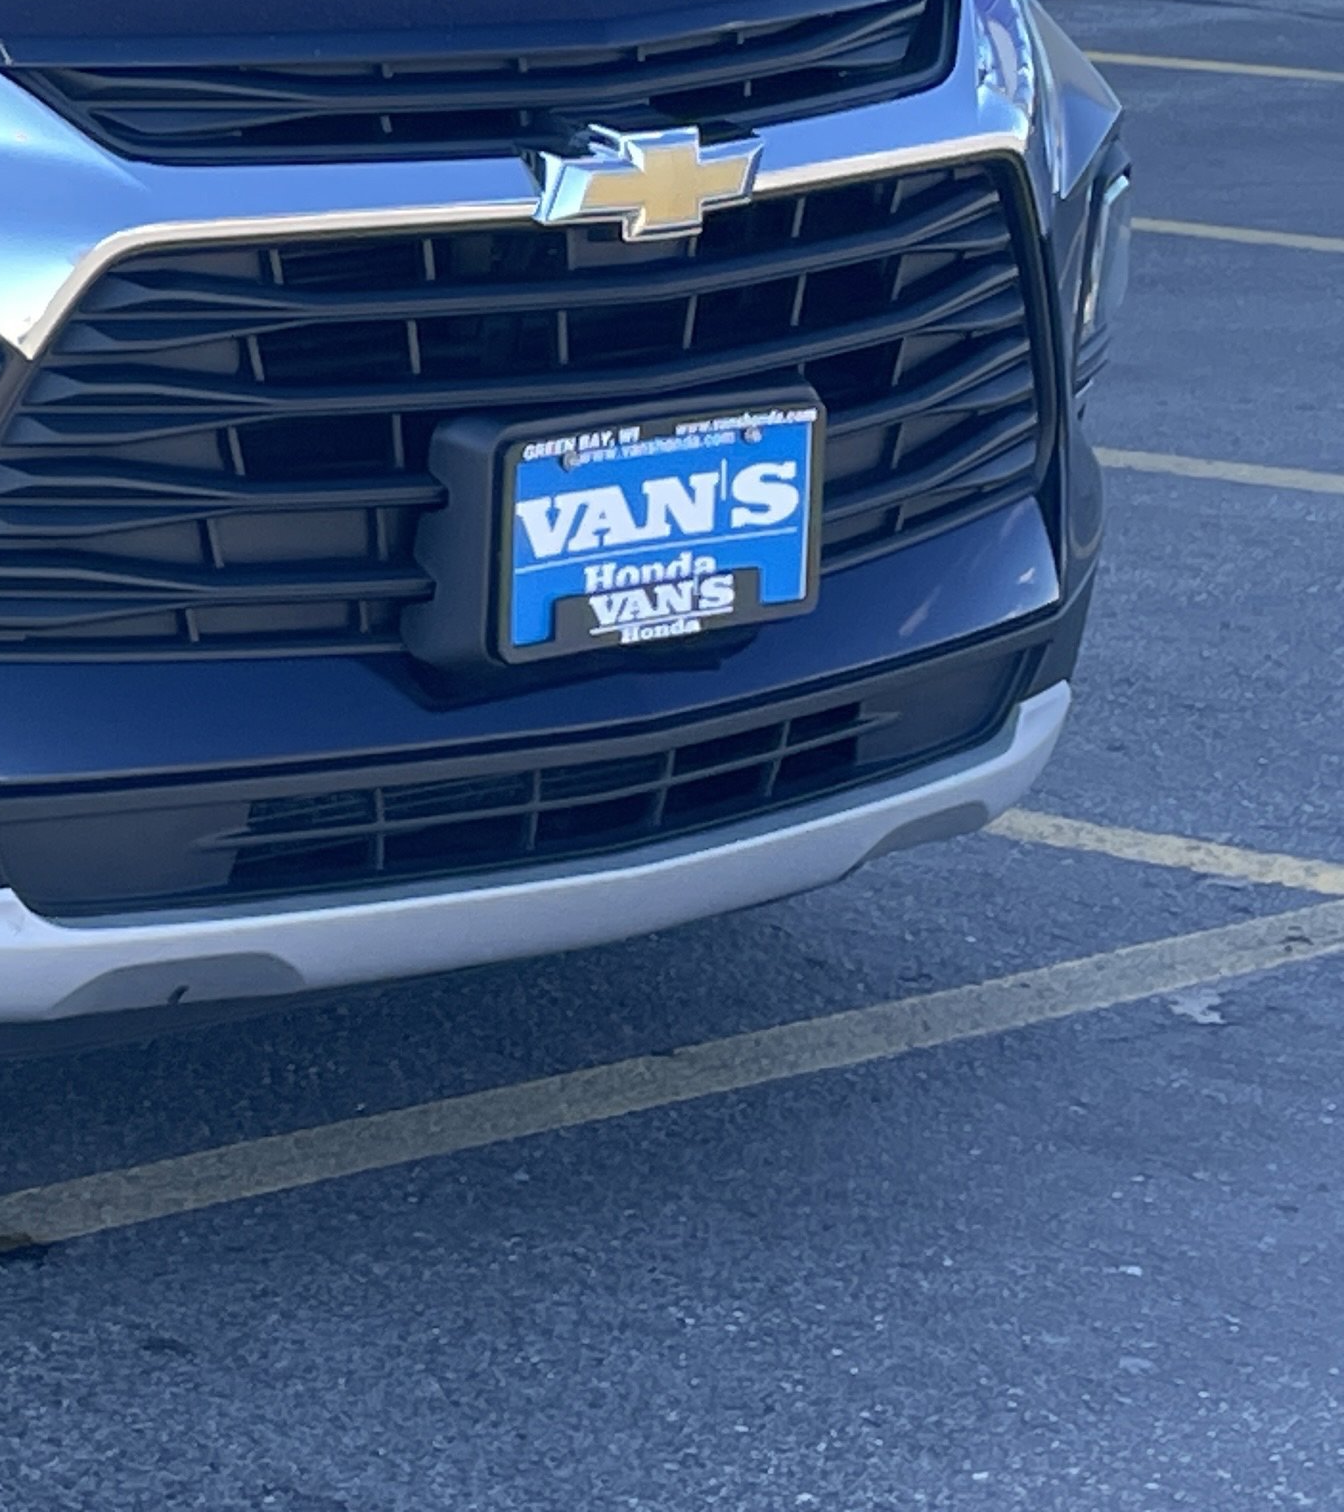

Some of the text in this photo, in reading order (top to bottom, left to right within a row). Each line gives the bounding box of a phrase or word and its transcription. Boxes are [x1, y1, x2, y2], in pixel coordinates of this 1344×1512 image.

[522, 437, 576, 462] GREEN
[618, 426, 640, 446] WI
[515, 458, 800, 559] VAN'S
[583, 551, 717, 594] Honda
[588, 573, 735, 626] VAN'S
[620, 617, 702, 644] Honda
